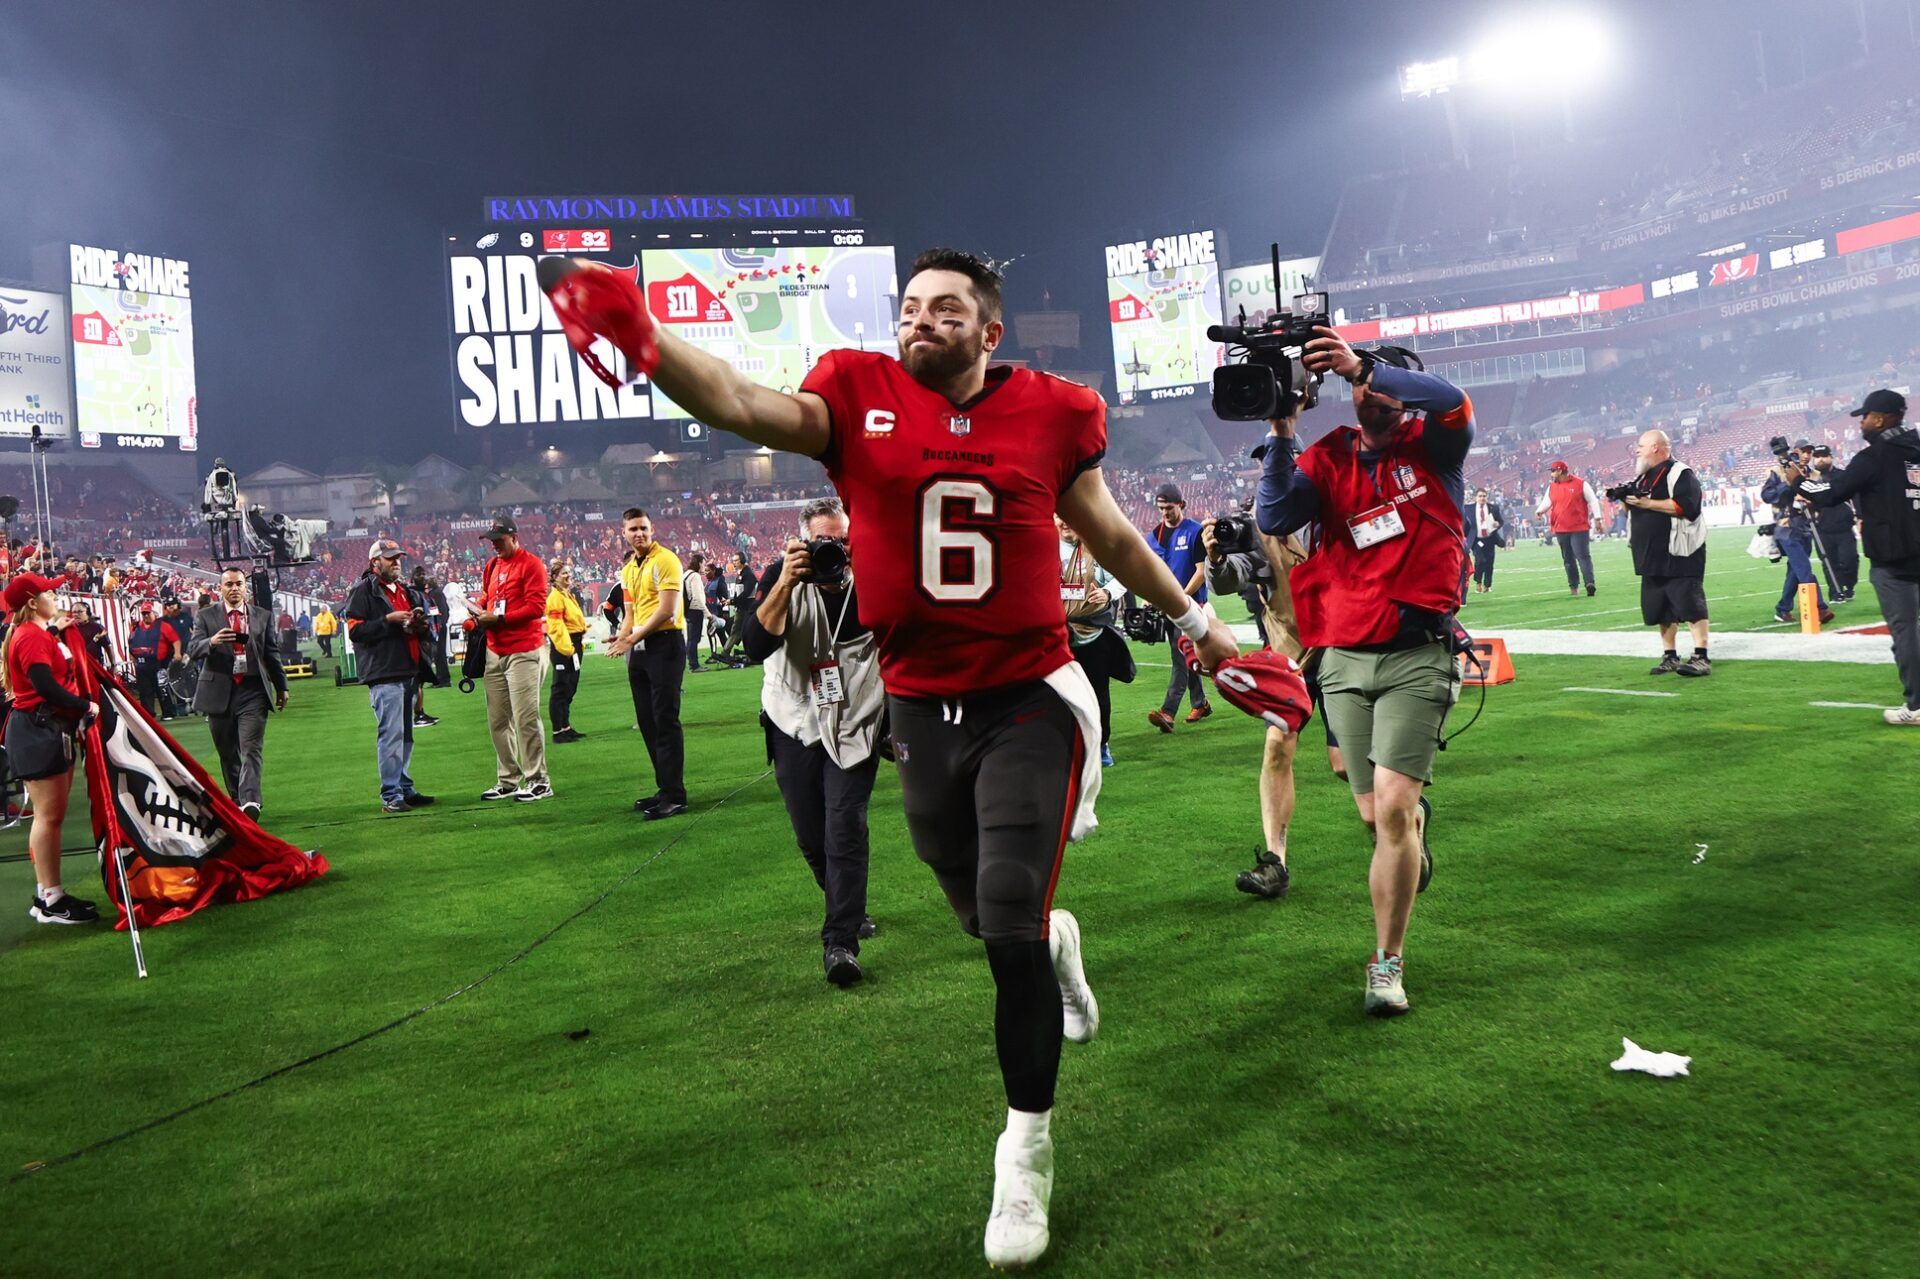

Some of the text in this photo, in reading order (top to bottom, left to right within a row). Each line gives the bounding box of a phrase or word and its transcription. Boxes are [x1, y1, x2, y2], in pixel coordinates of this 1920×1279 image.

[1820, 177, 1834, 190] 55
[1837, 159, 1894, 185] DERRICK
[491, 197, 850, 221] RAYMOND JAMES STADIUM
[1697, 188, 1789, 224] 40 MIKE ALSTOTT
[519, 232, 534, 248] 9
[581, 231, 607, 247] 32
[833, 234, 864, 246] 0:00
[1612, 233, 1637, 249] JOHN
[1638, 223, 1672, 241] LYNCH
[1105, 230, 1216, 278] RIDE SHARE
[69, 243, 190, 298] RIDE SHARE
[1455, 261, 1499, 276] RONDE
[1720, 273, 1879, 318] SUPER BOWL CHAMPIONS
[25, 352, 62, 364] THIRD
[688, 423, 701, 438] 0
[865, 409, 896, 433] C
[923, 448, 995, 466] BUCCANEERS
[1394, 485, 1428, 504] TELVISION
[450, 519, 494, 530] BUCCANEE
[918, 476, 998, 604] 6
